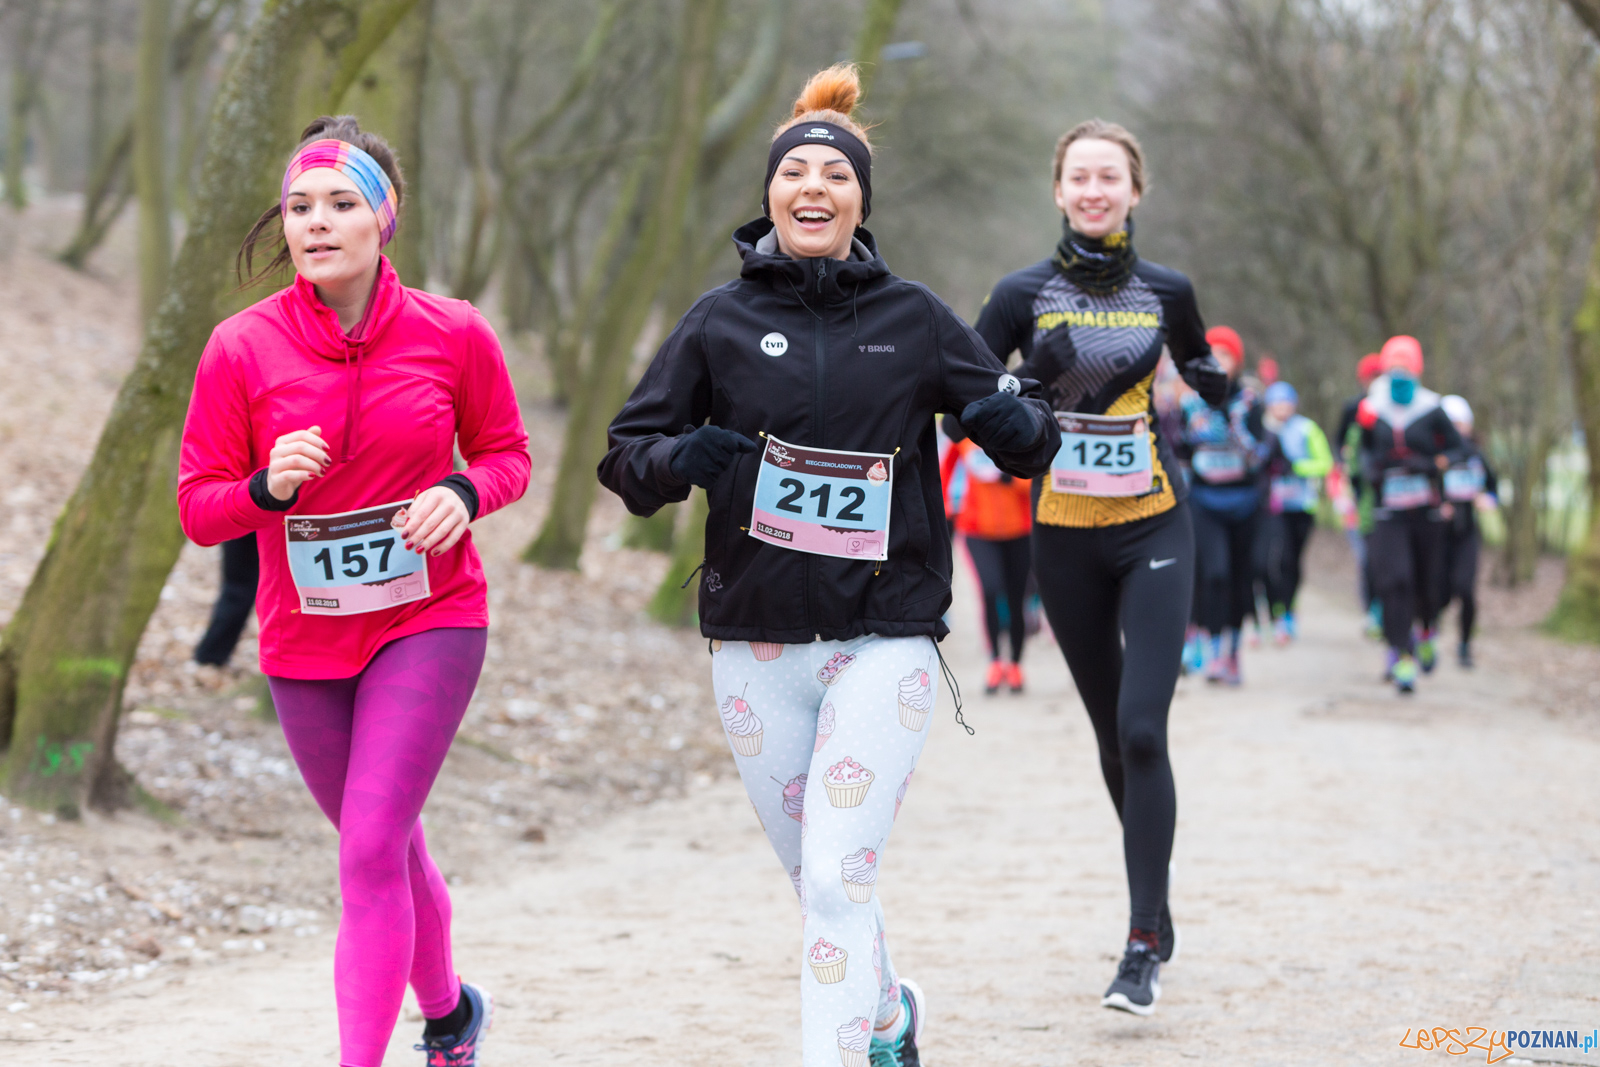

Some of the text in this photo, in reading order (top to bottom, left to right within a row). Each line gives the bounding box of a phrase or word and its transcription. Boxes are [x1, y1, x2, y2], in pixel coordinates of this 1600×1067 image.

[765, 340, 784, 349] tvn
[867, 345, 895, 353] BRUGI
[1073, 440, 1135, 467] 125
[805, 459, 863, 471] BIEGCZEKOLADOWY.PL
[776, 477, 866, 522] 212
[757, 523, 791, 540] 11.02.2018
[314, 537, 395, 581] 157
[307, 598, 338, 607] 11.02.2018
